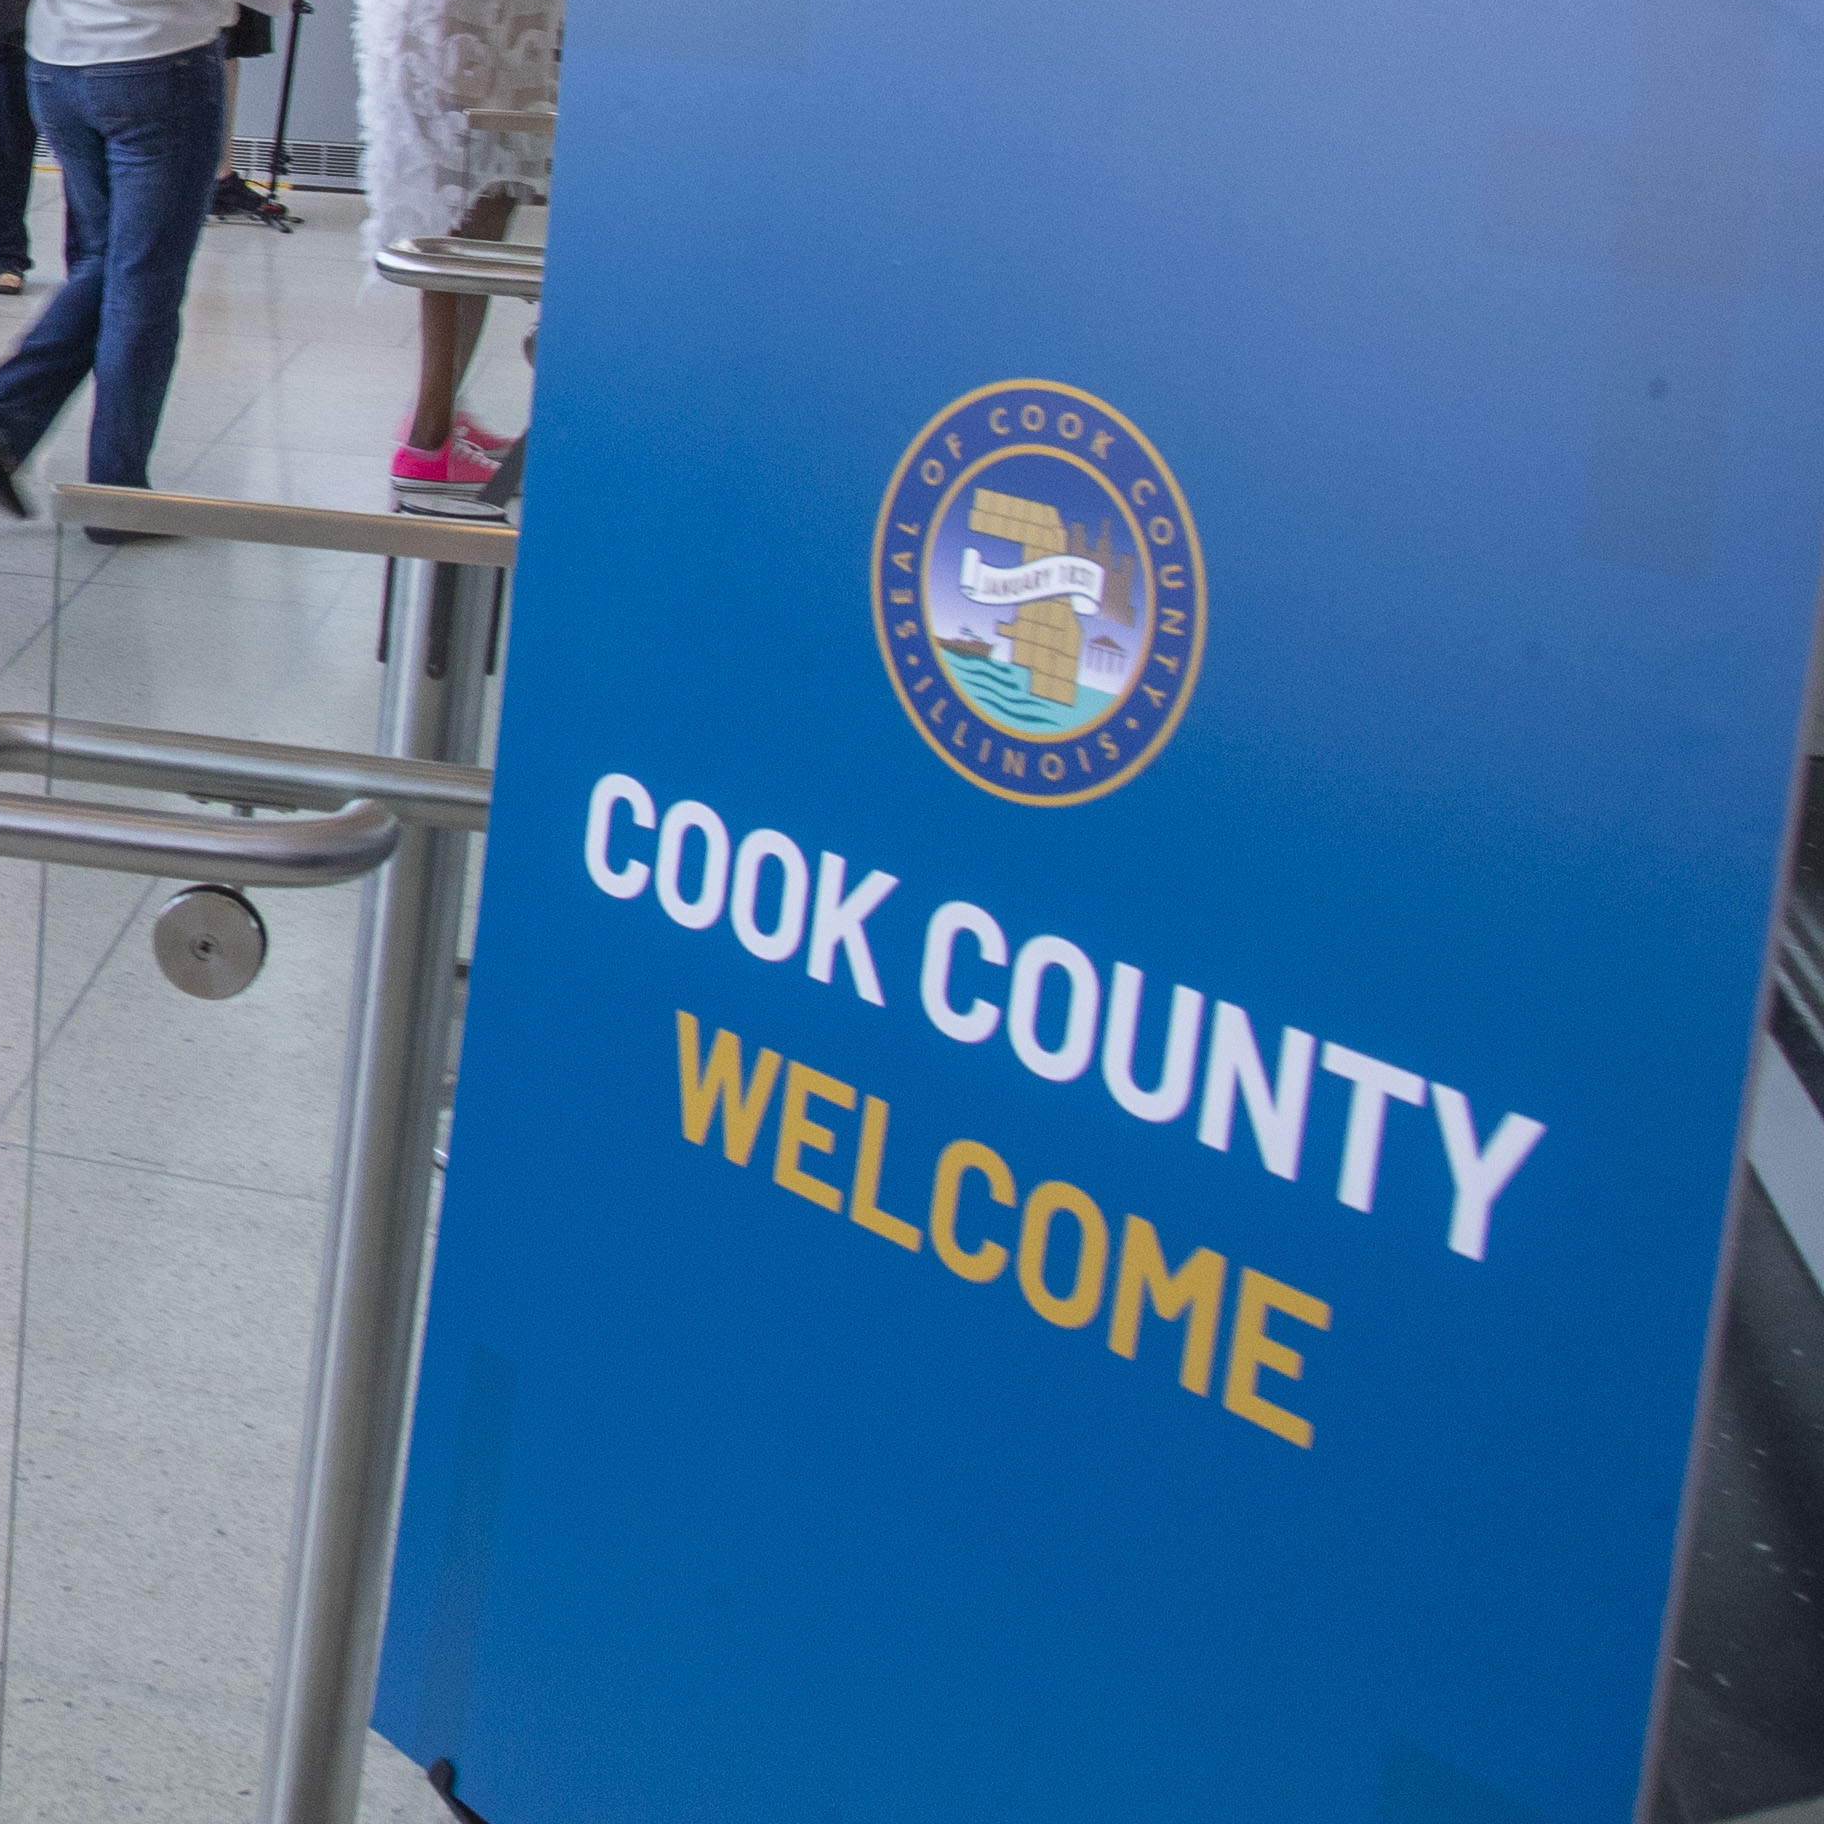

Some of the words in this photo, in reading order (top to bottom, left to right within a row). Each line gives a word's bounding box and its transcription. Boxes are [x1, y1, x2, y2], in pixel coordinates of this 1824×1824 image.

[889, 520, 923, 641] SEAL
[919, 431, 965, 488] OF
[988, 404, 1117, 462] COOK
[1129, 478, 1188, 710] COUNTY
[913, 675, 1124, 783] ILLINOIS
[585, 773, 899, 1008] COOK
[922, 901, 1545, 1262] COUNTY
[676, 1010, 1330, 1450] WELCOME
